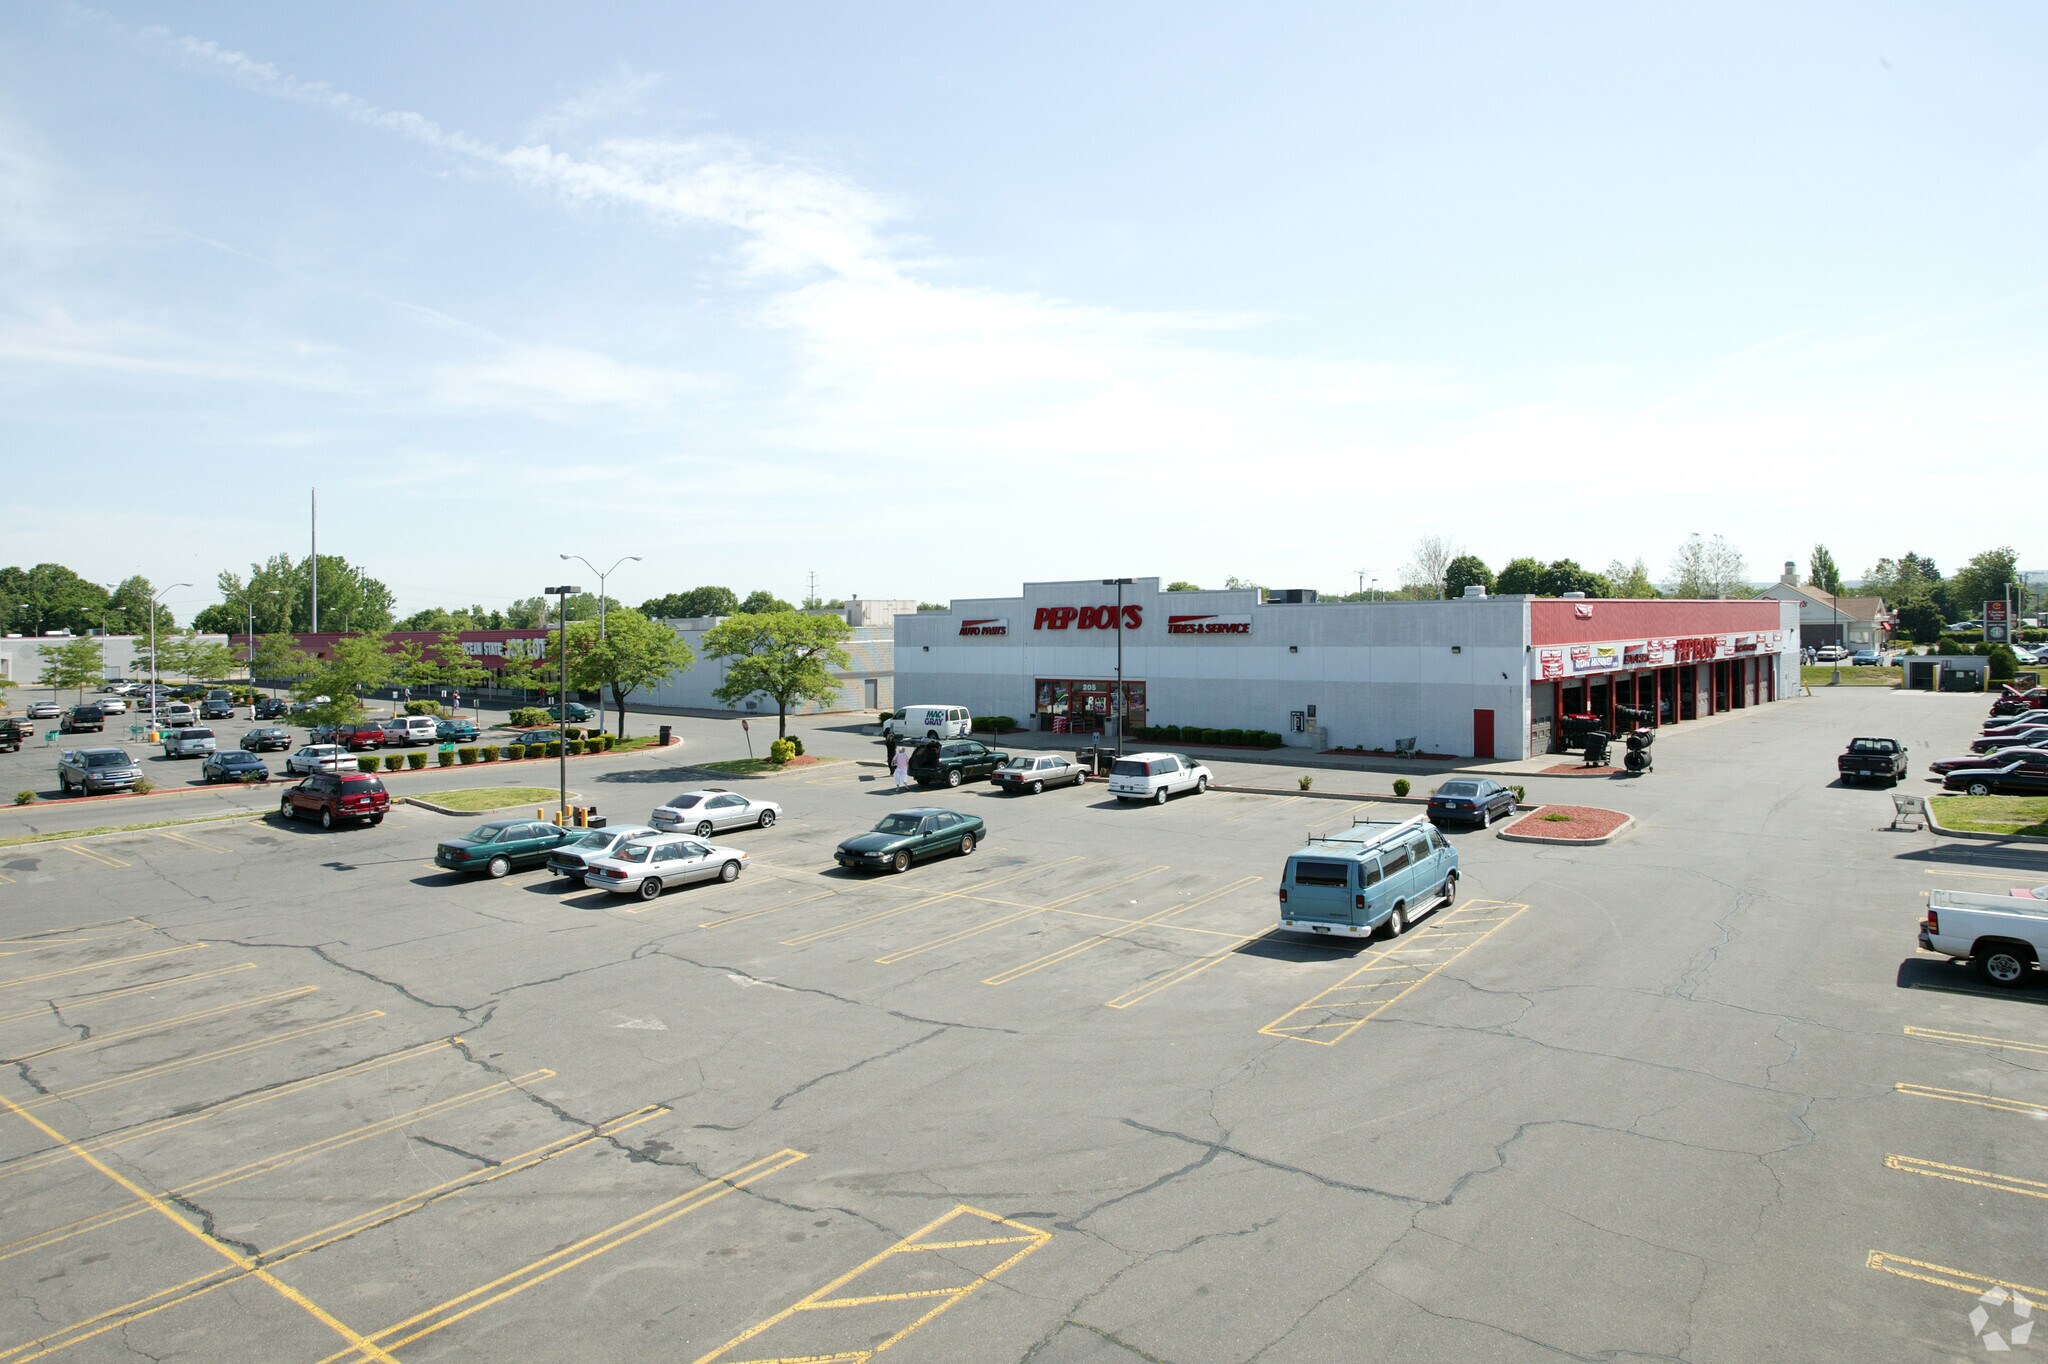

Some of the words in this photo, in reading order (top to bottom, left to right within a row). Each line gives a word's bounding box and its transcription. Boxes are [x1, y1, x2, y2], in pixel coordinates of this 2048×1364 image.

[1033, 607, 1078, 630] PEP
[1077, 604, 1143, 630] BOYS
[959, 626, 980, 636] AUTO
[980, 626, 1006, 635] PARTS
[1167, 623, 1197, 634] TIRES
[1197, 623, 1205, 634] &
[1205, 623, 1251, 634] SERVICE
[483, 641, 504, 656] STATE
[1082, 683, 1097, 691] 205
[924, 718, 943, 726] GRAY
